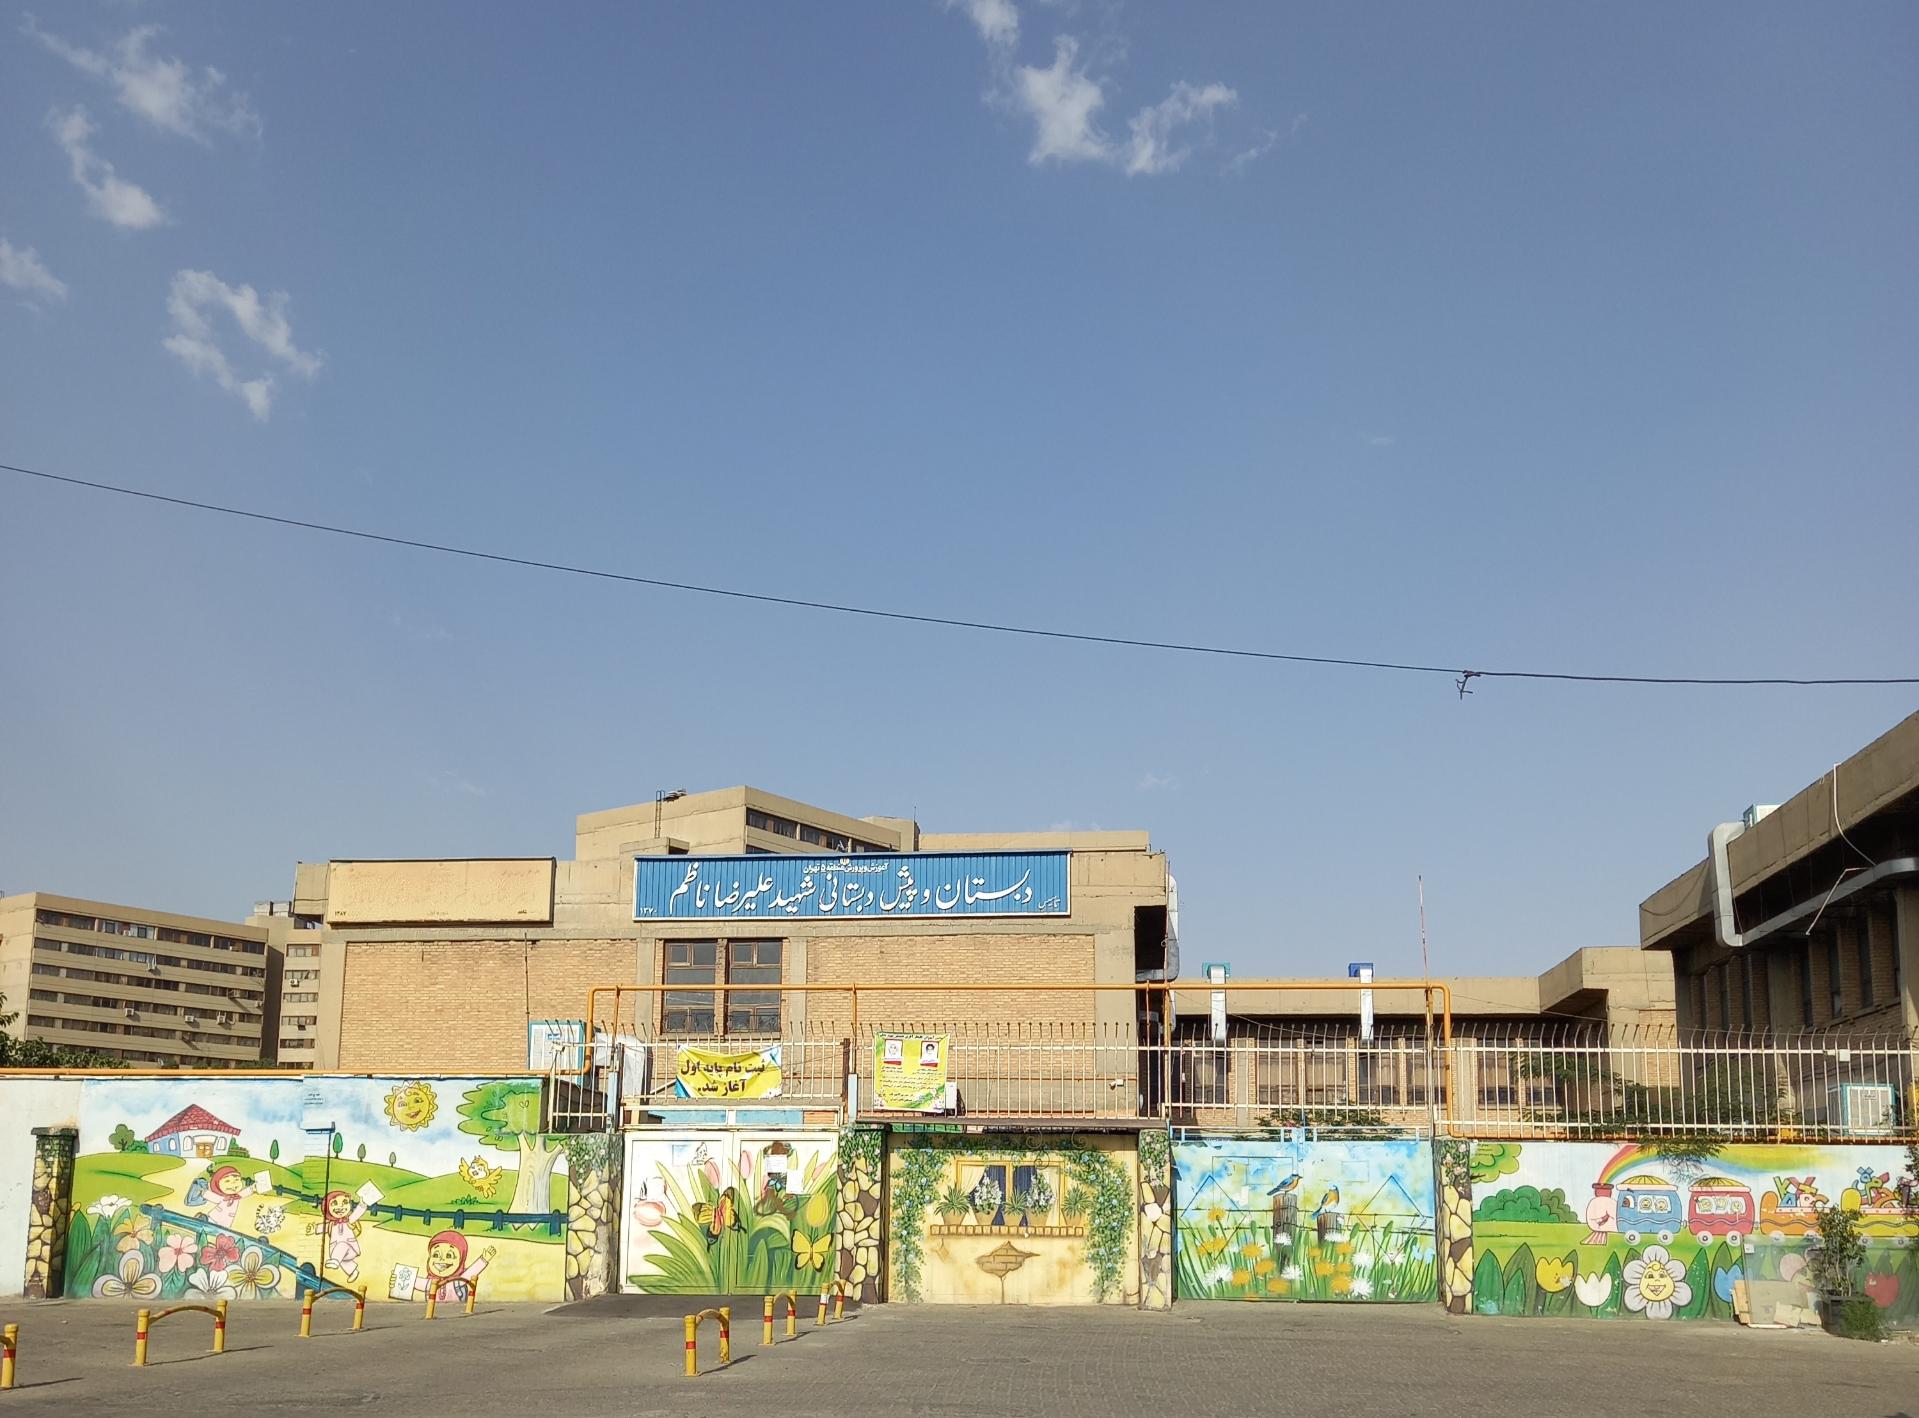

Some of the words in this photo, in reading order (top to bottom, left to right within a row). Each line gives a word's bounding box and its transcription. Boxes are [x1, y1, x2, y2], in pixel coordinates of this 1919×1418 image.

[669, 862, 711, 915] ناظم
[714, 872, 774, 914] علیرضا
[767, 875, 817, 914] شهید
[818, 873, 875, 913] دبستانی
[879, 865, 918, 911] پیش
[920, 888, 931, 906] و
[935, 868, 1033, 910] دبستان
[680, 1060, 701, 1076] اول
[703, 1062, 723, 1078] پایه
[725, 1062, 742, 1077] نام
[744, 1058, 766, 1076] ثبت
[721, 1078, 747, 1097] آغاز
